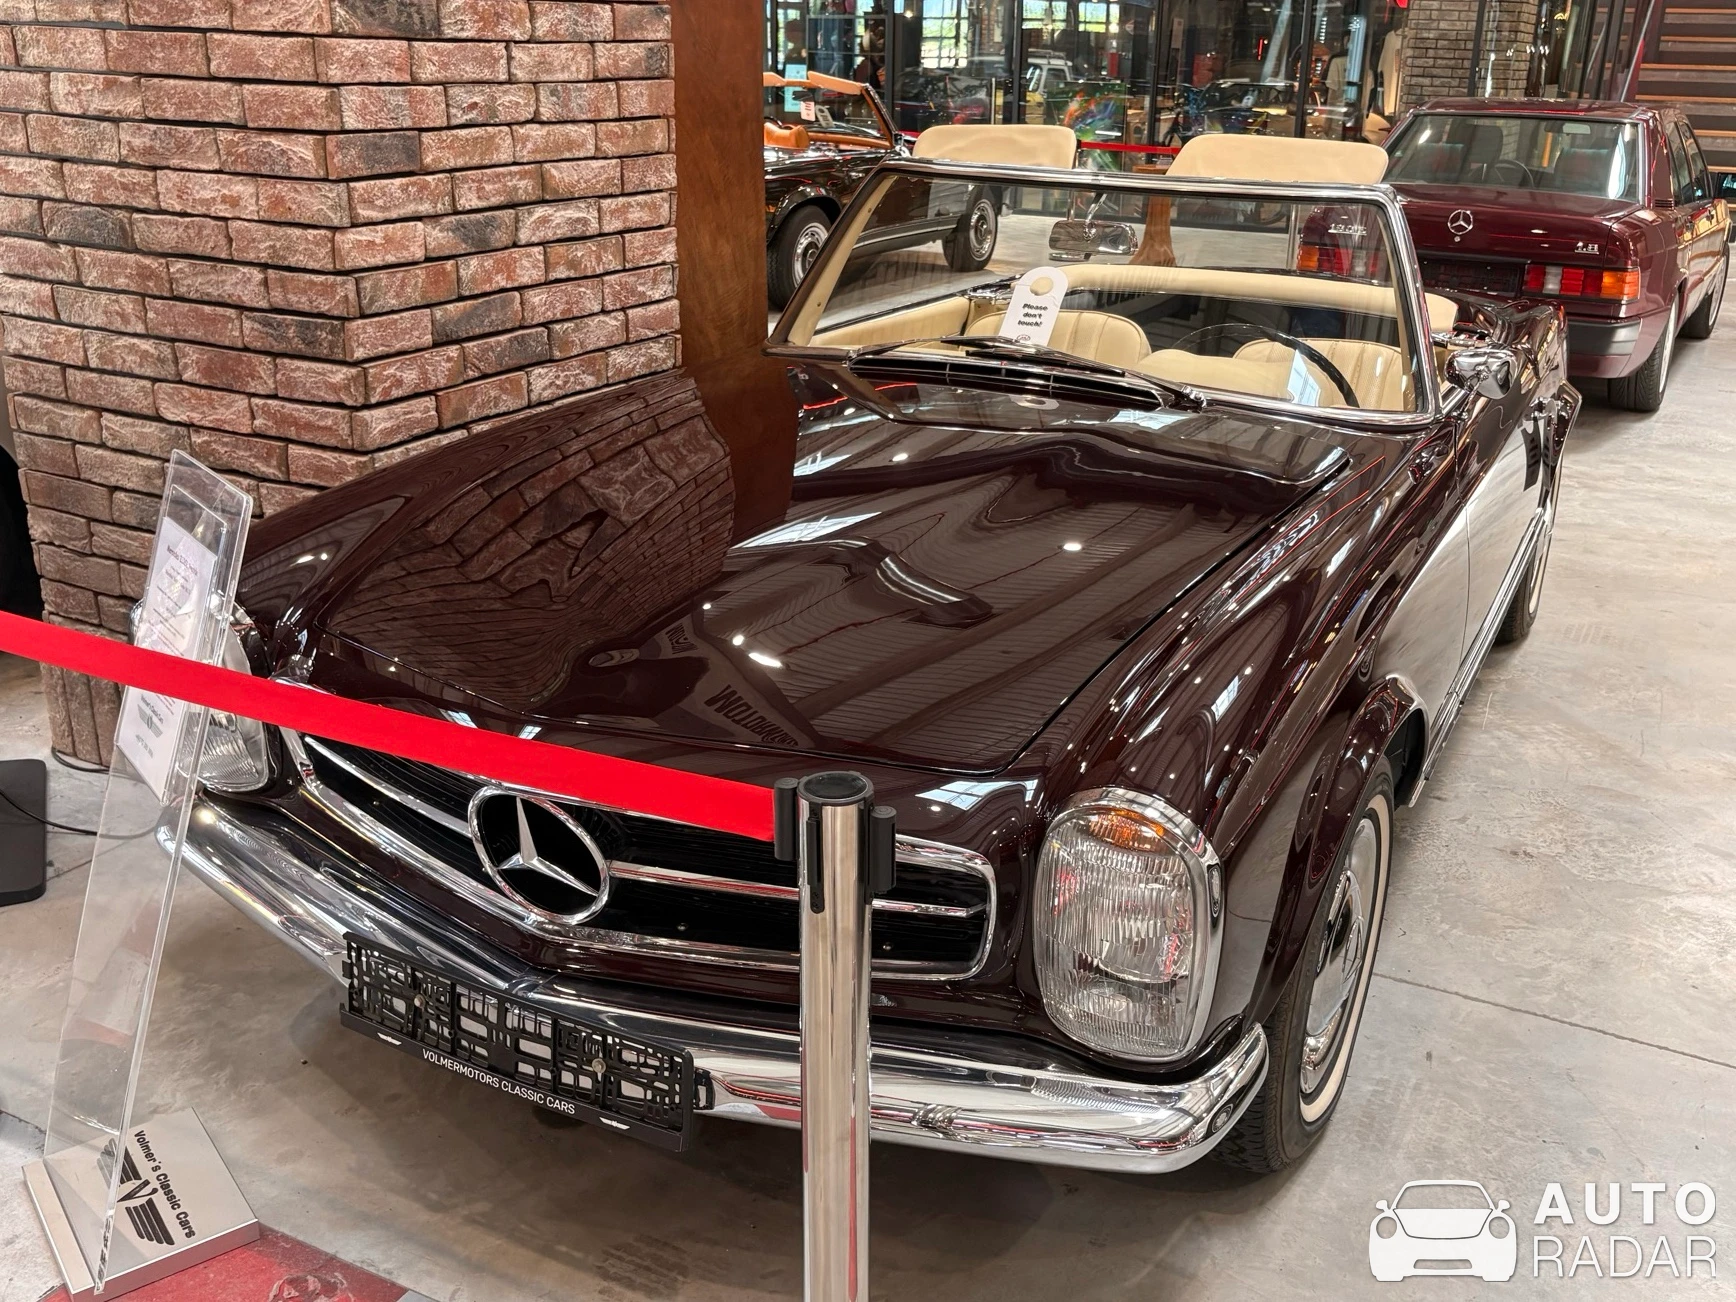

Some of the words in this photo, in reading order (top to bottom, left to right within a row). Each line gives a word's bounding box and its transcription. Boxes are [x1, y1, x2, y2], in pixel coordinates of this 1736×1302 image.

[1022, 303, 1048, 311] Please
[422, 1048, 500, 1088] VOLMERMOTORS
[501, 1080, 544, 1104] CLASSIC
[546, 1096, 575, 1115] CARS
[155, 1172, 182, 1211] Classic
[175, 1211, 196, 1239] Cars
